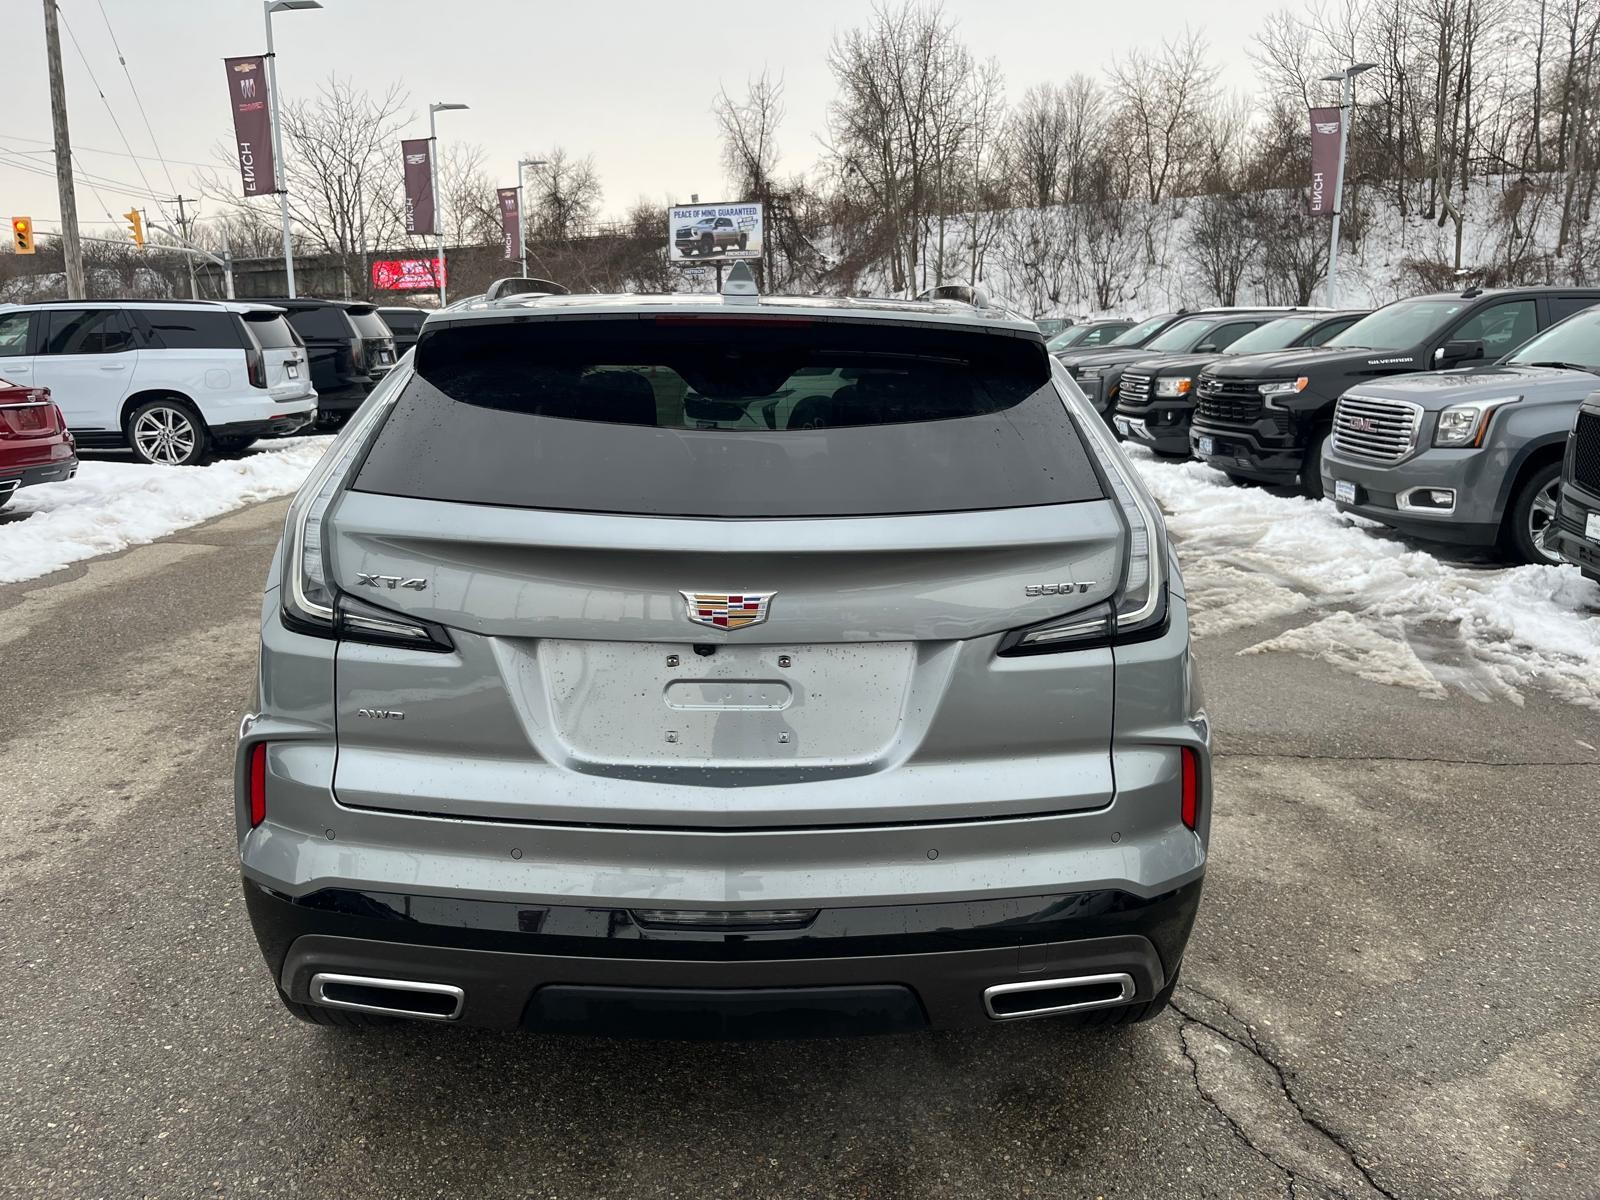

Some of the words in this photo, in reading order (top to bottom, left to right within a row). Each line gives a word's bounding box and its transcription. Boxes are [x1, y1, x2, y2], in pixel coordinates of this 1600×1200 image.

[674, 210, 692, 219] PEACE
[1367, 357, 1413, 365] SILVERADO
[1350, 416, 1379, 433] GMC
[356, 572, 427, 592] XT4
[358, 709, 404, 720] AWD
